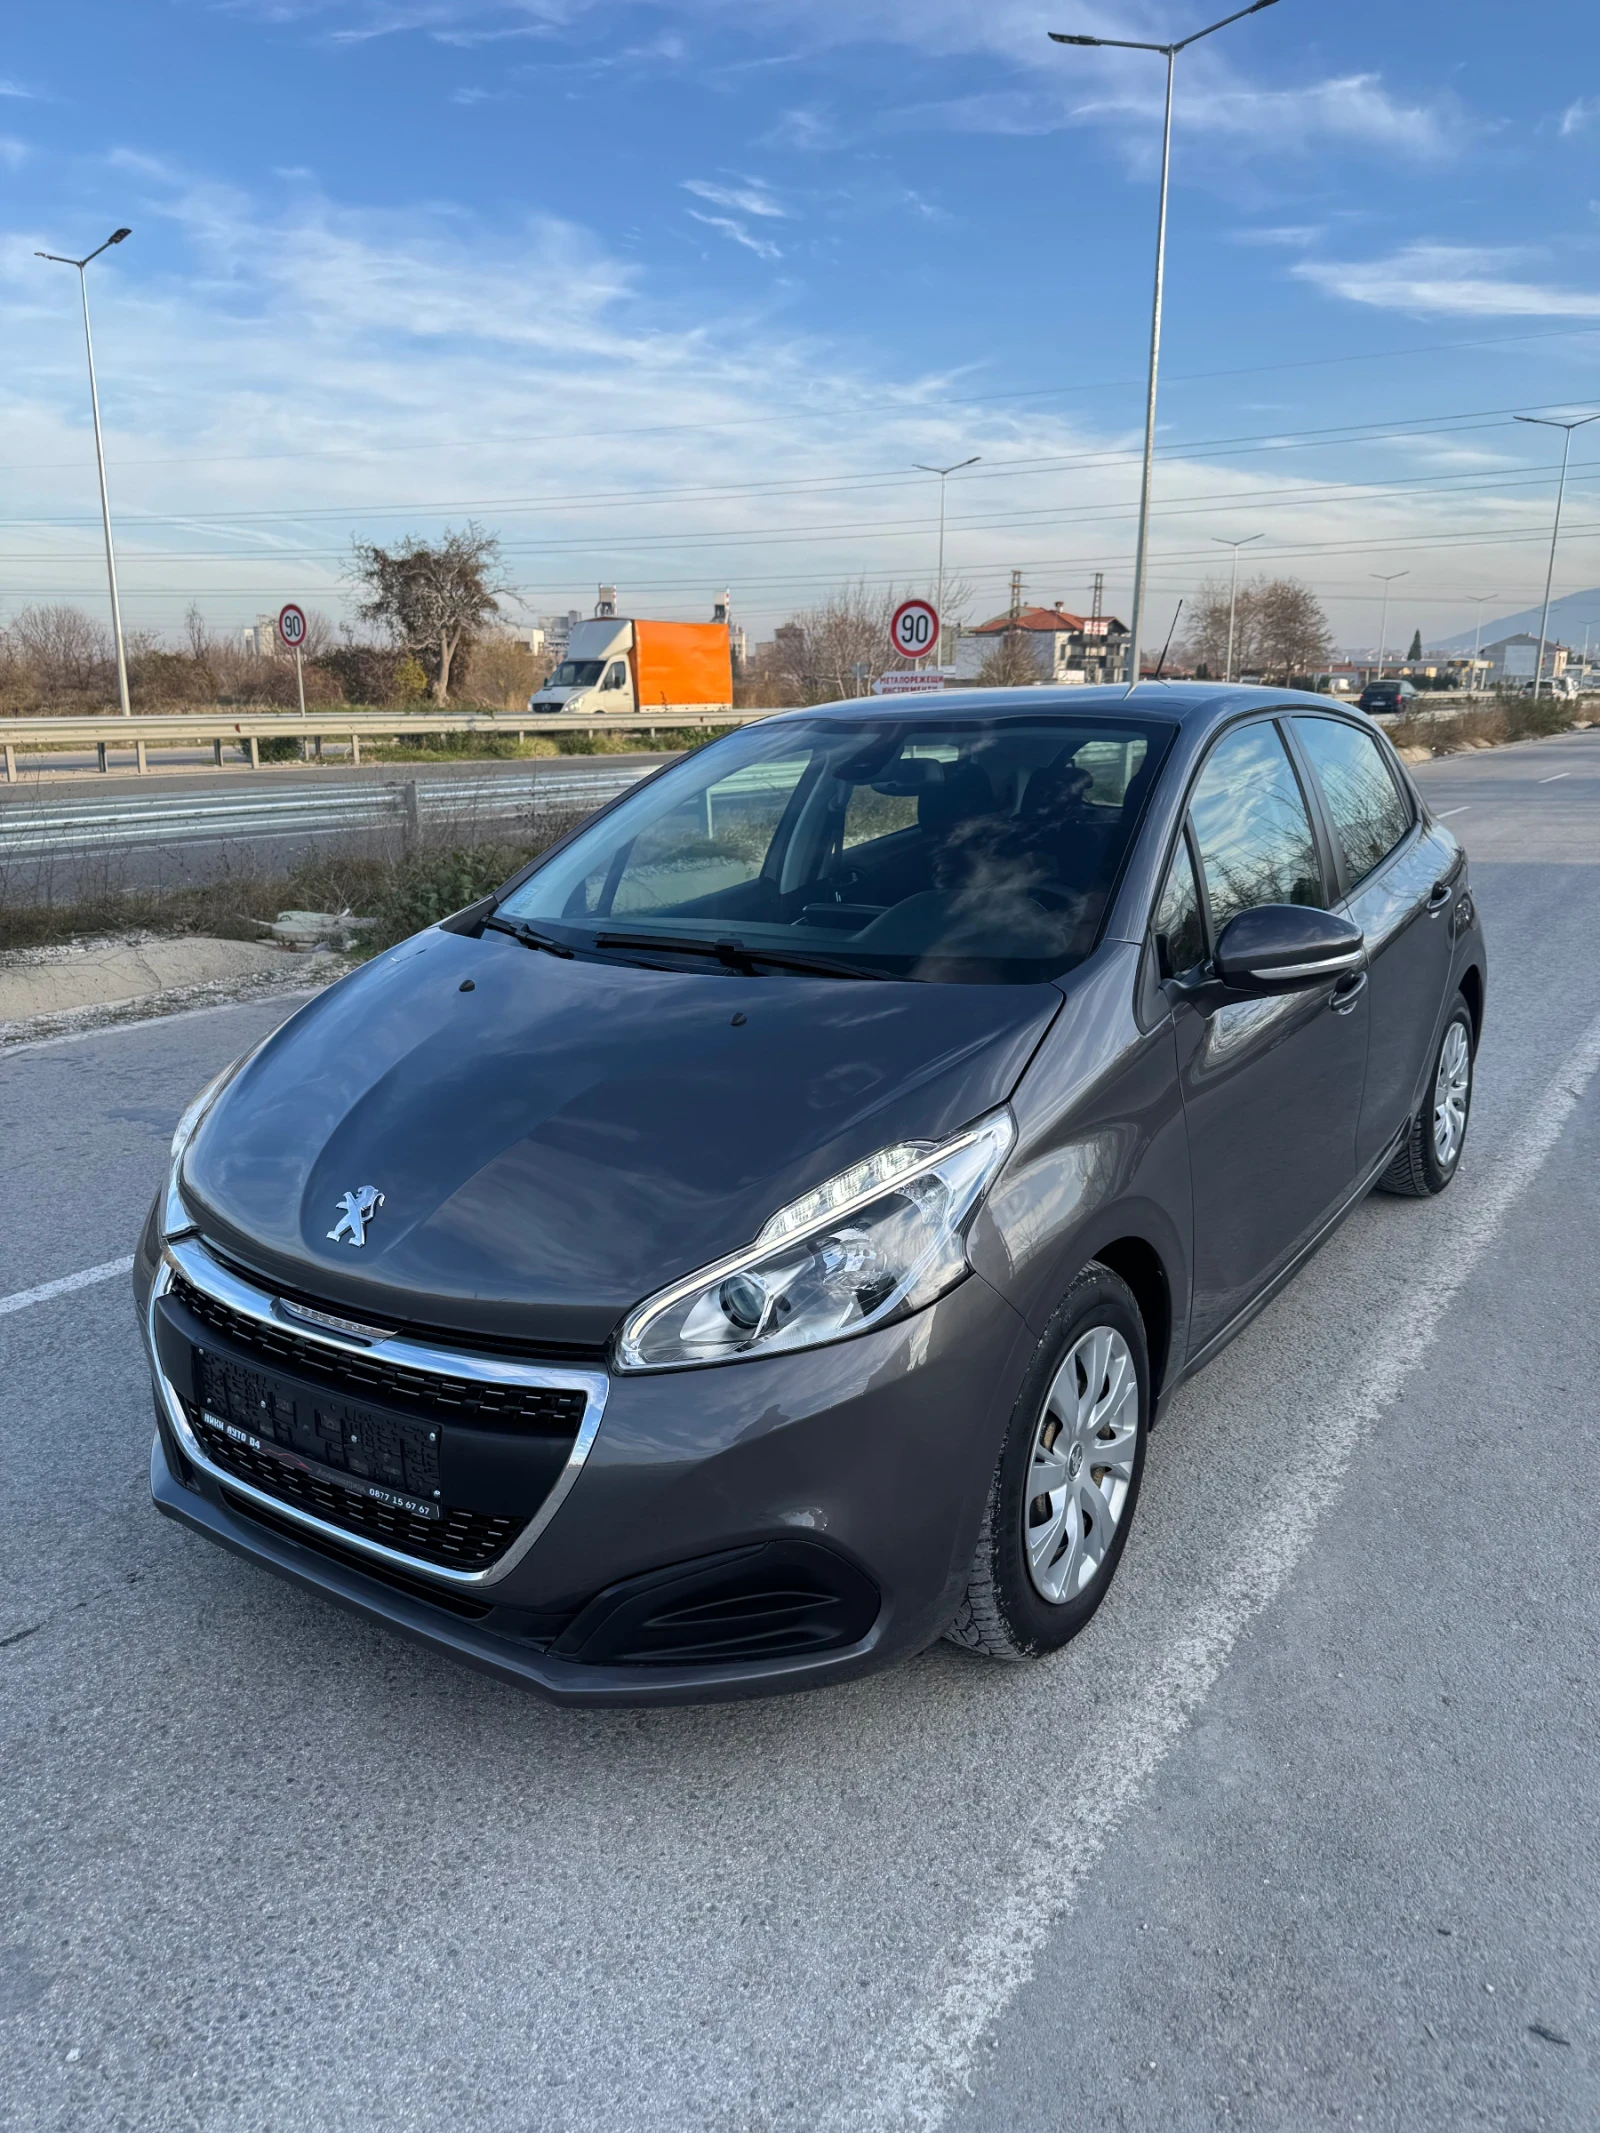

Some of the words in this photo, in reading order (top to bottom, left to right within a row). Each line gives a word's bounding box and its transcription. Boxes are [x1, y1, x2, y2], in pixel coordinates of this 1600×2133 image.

[285, 615, 301, 637] 90
[902, 614, 929, 644] 90
[369, 1488, 390, 1501] 0877
[392, 1496, 404, 1506] 15
[405, 1501, 417, 1511] 67
[418, 1505, 430, 1515] 67
